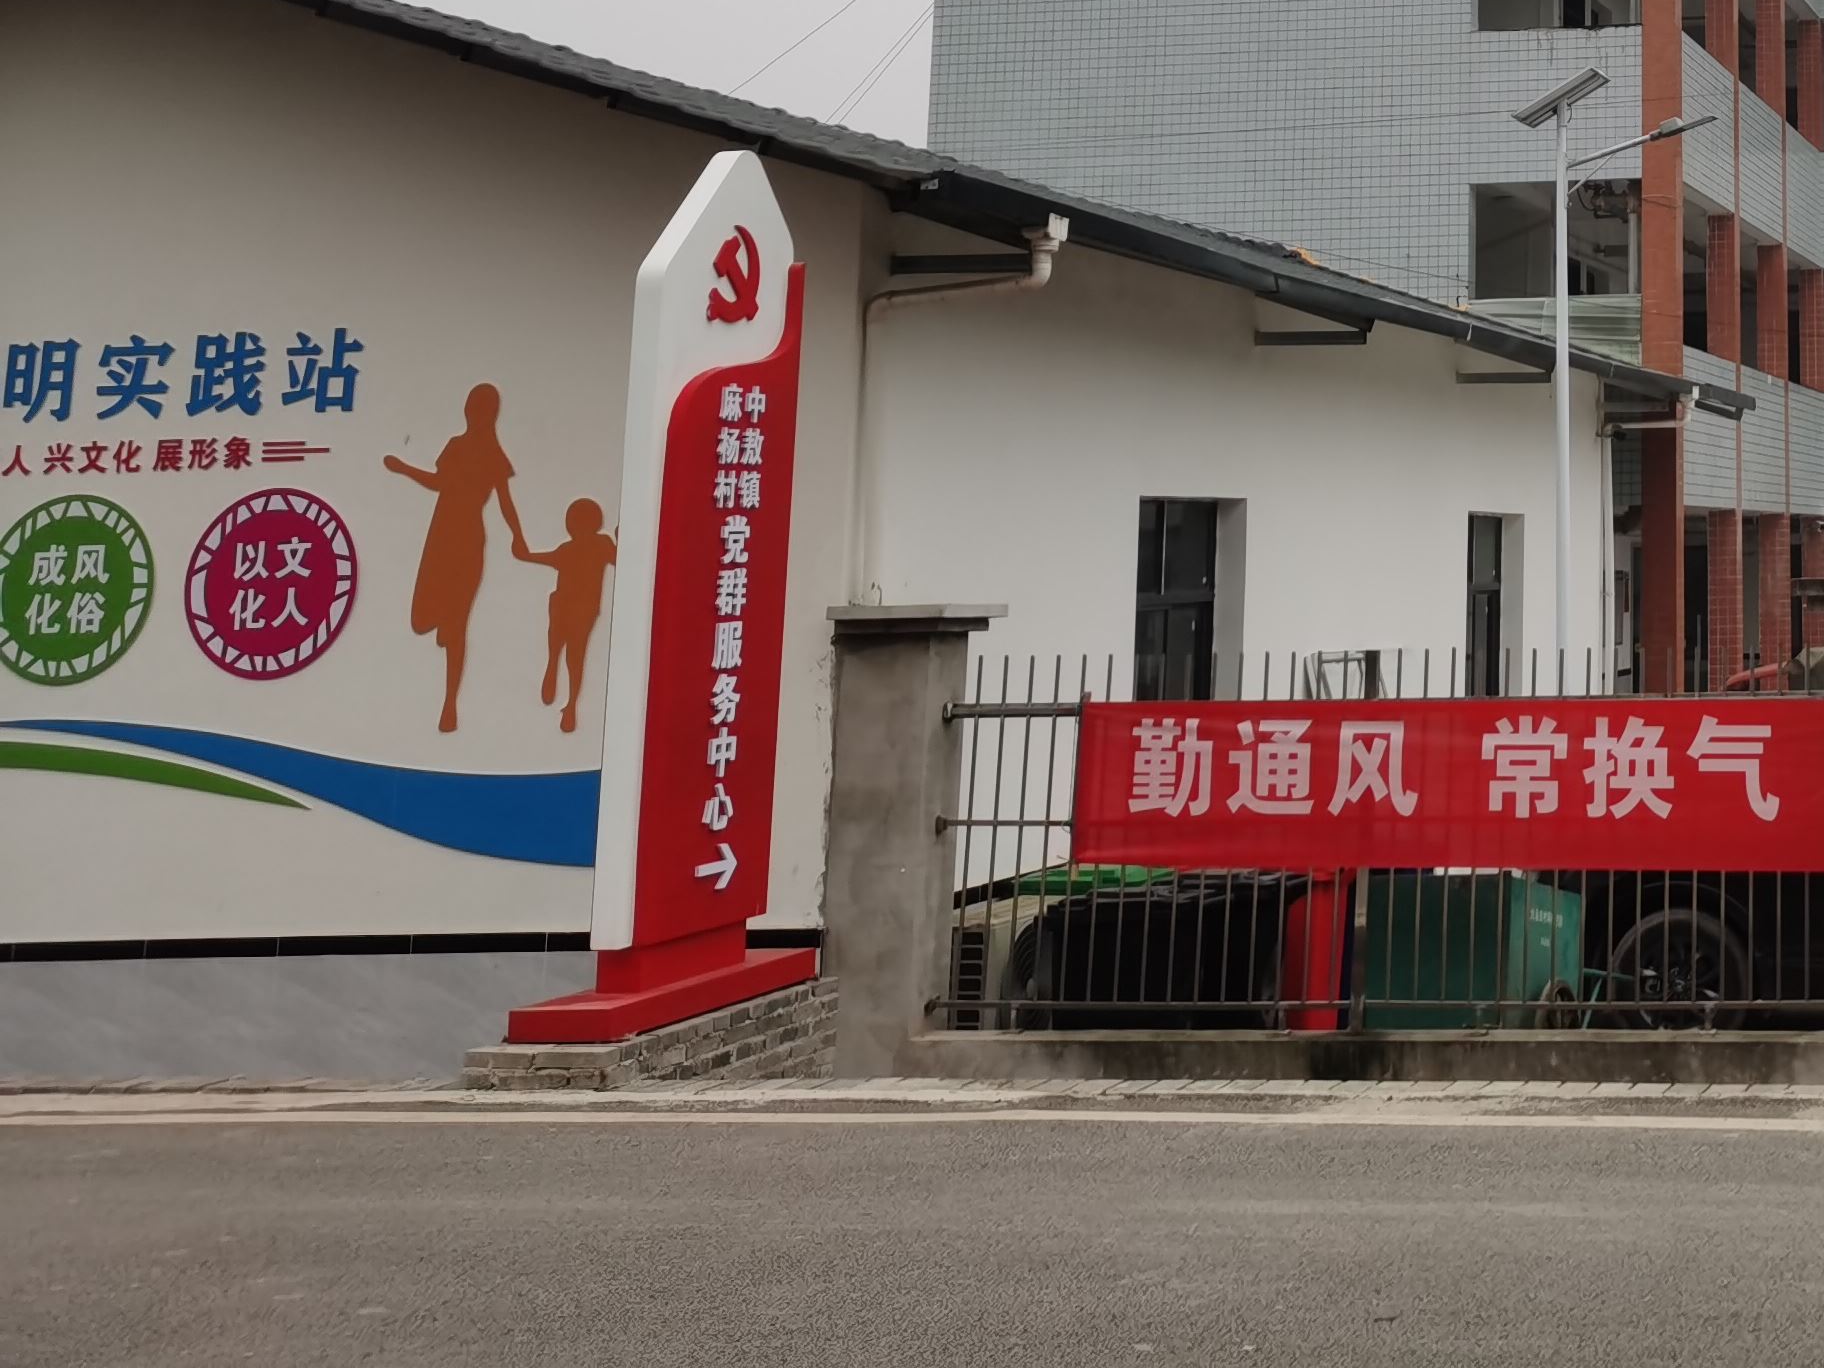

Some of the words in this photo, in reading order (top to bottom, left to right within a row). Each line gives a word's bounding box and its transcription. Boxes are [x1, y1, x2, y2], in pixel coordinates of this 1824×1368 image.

[3, 327, 364, 423] 明实践站
[43, 440, 143, 475] 兴文化
[152, 436, 254, 473] 展形象
[712, 383, 743, 510] 麻杨村
[28, 543, 110, 587] 成风
[232, 536, 313, 582] 以文
[25, 591, 106, 636] 化俗
[229, 586, 310, 631] 化人
[700, 514, 752, 832] 党群服务中心
[1127, 717, 1418, 817] 勤通风
[1481, 715, 1780, 821] 常换气
